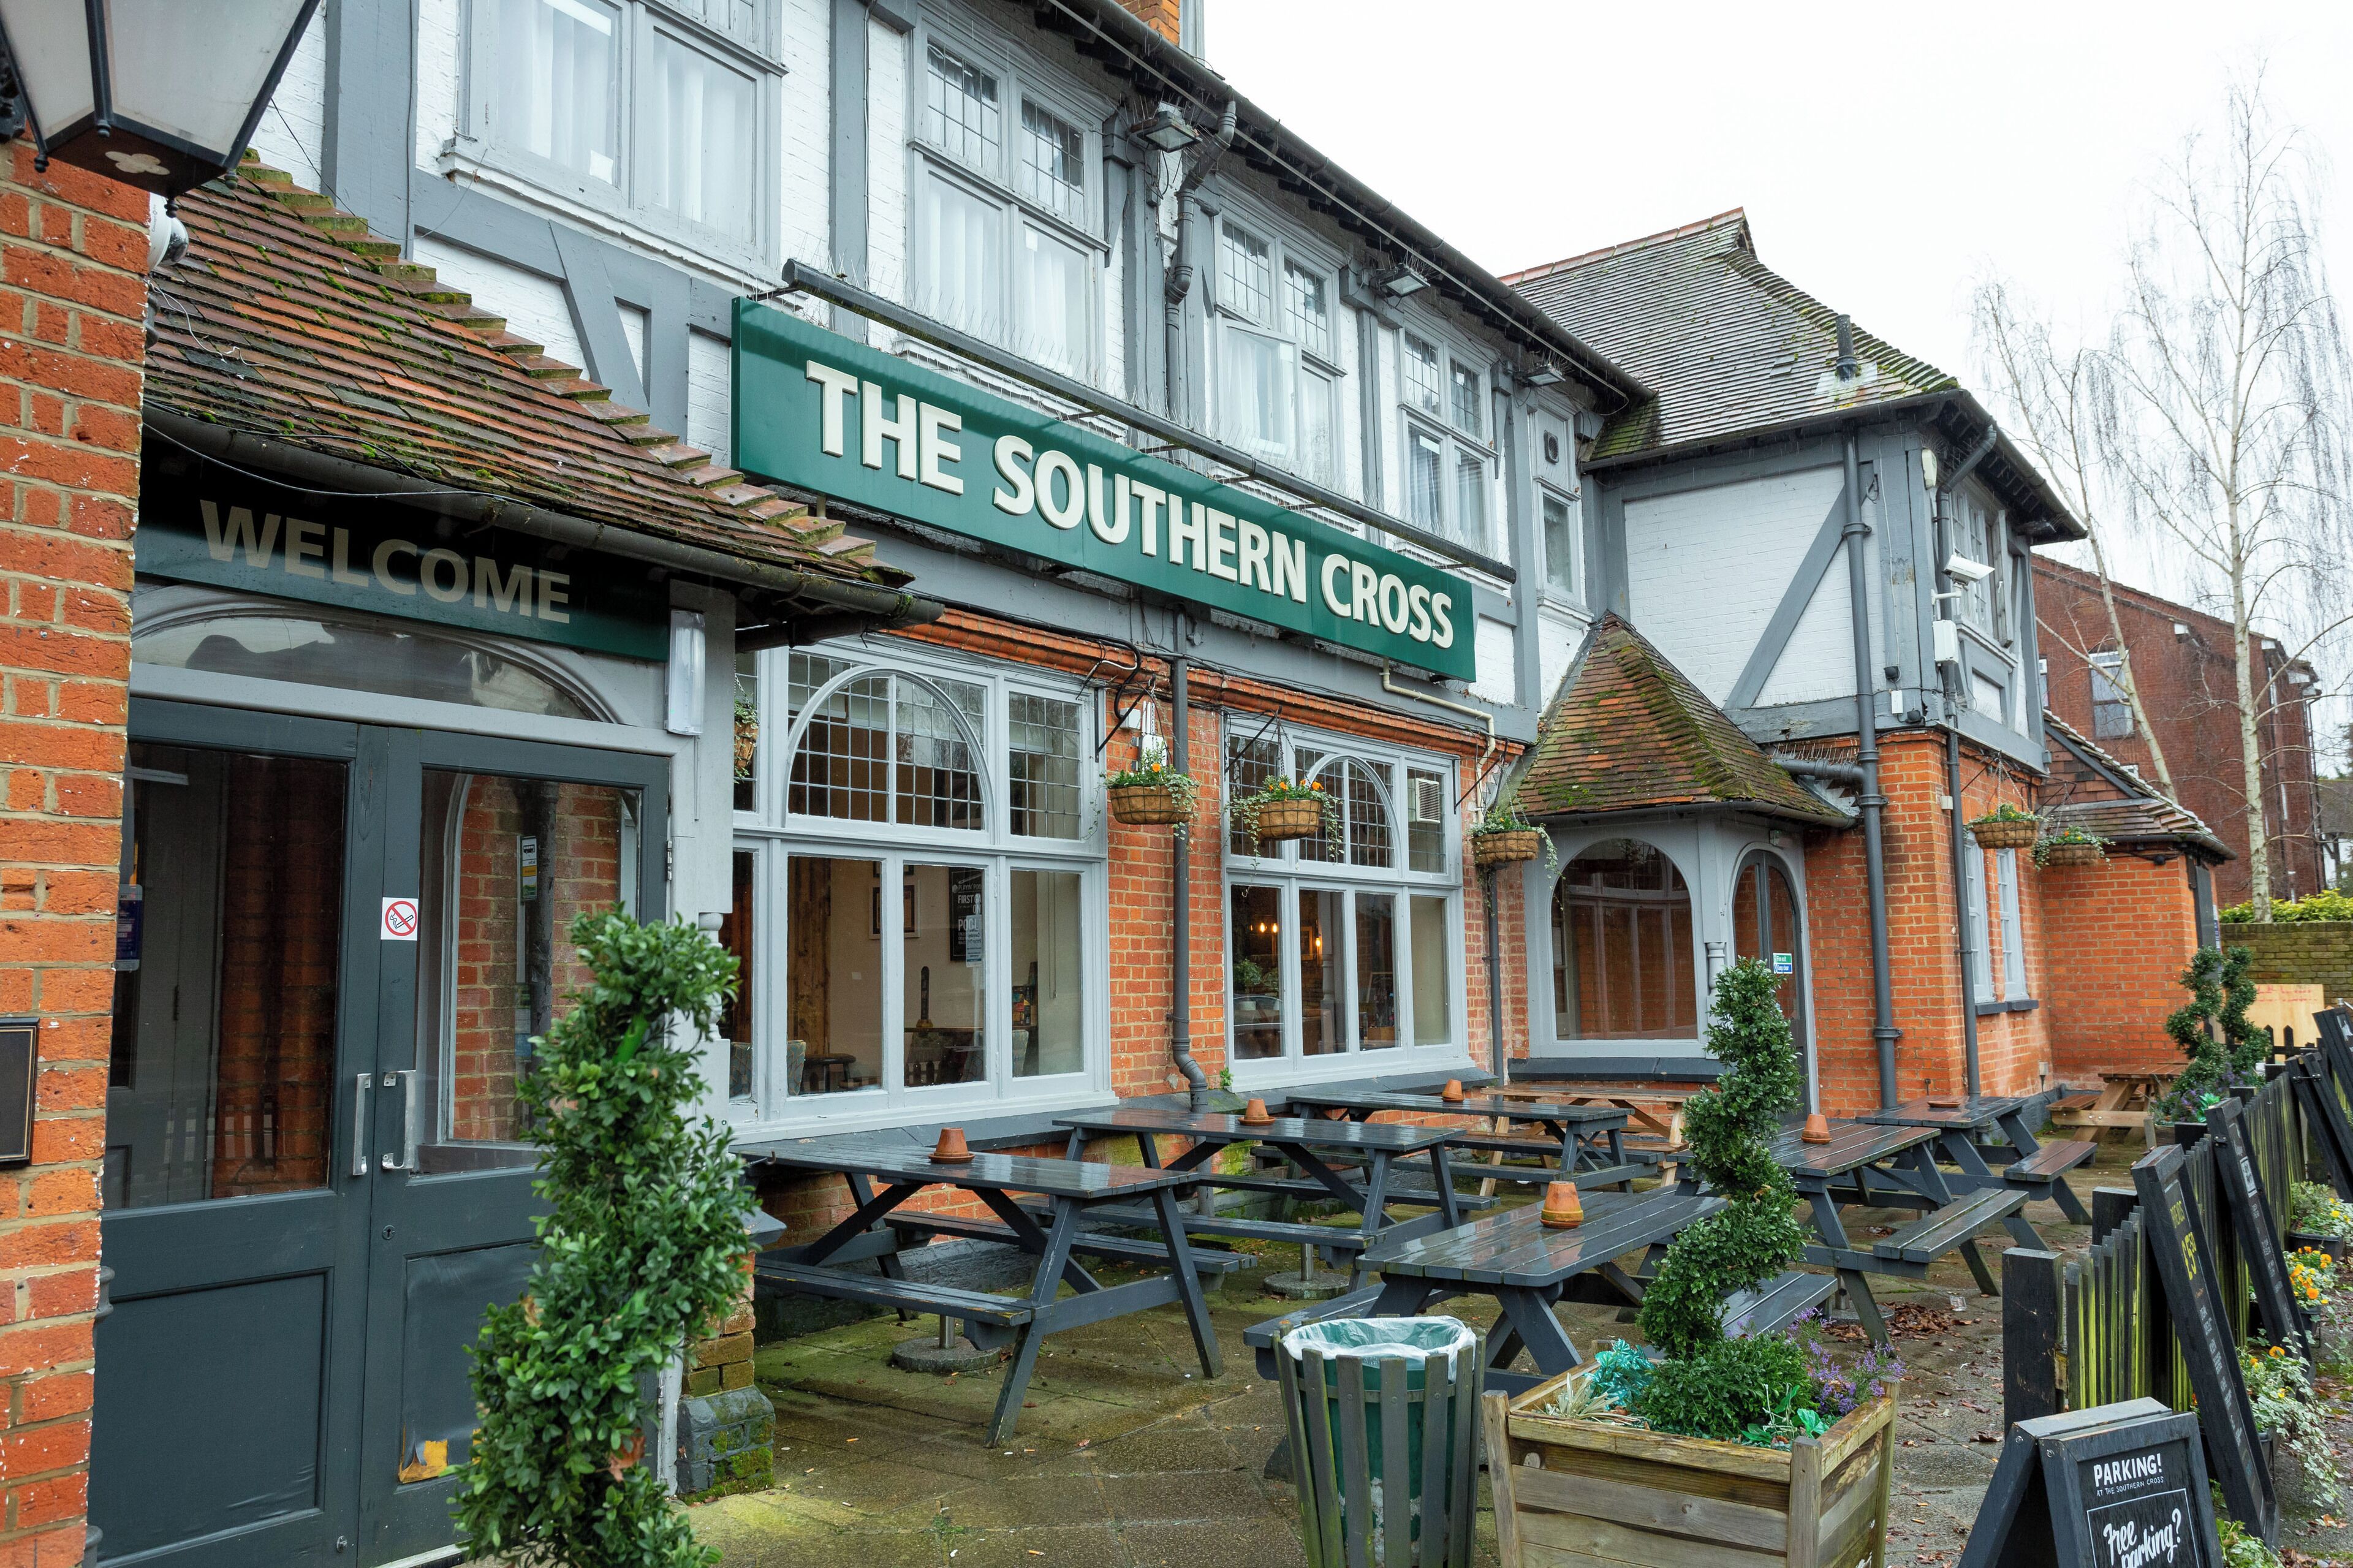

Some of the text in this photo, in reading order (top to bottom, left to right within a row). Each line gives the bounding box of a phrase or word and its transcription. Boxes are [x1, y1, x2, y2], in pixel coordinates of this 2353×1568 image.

[806, 360, 1453, 649] THE SOUTHERN CROSS
[200, 499, 570, 624] WELCOME
[958, 895, 974, 904] FIRST
[2093, 1453, 2162, 1487] PARKING!
[2116, 1481, 2145, 1493] SOUTHERN
[2146, 1476, 2164, 1485] CROSS
[2103, 1521, 2137, 1566] Free
[2121, 1508, 2181, 1568] parking?
